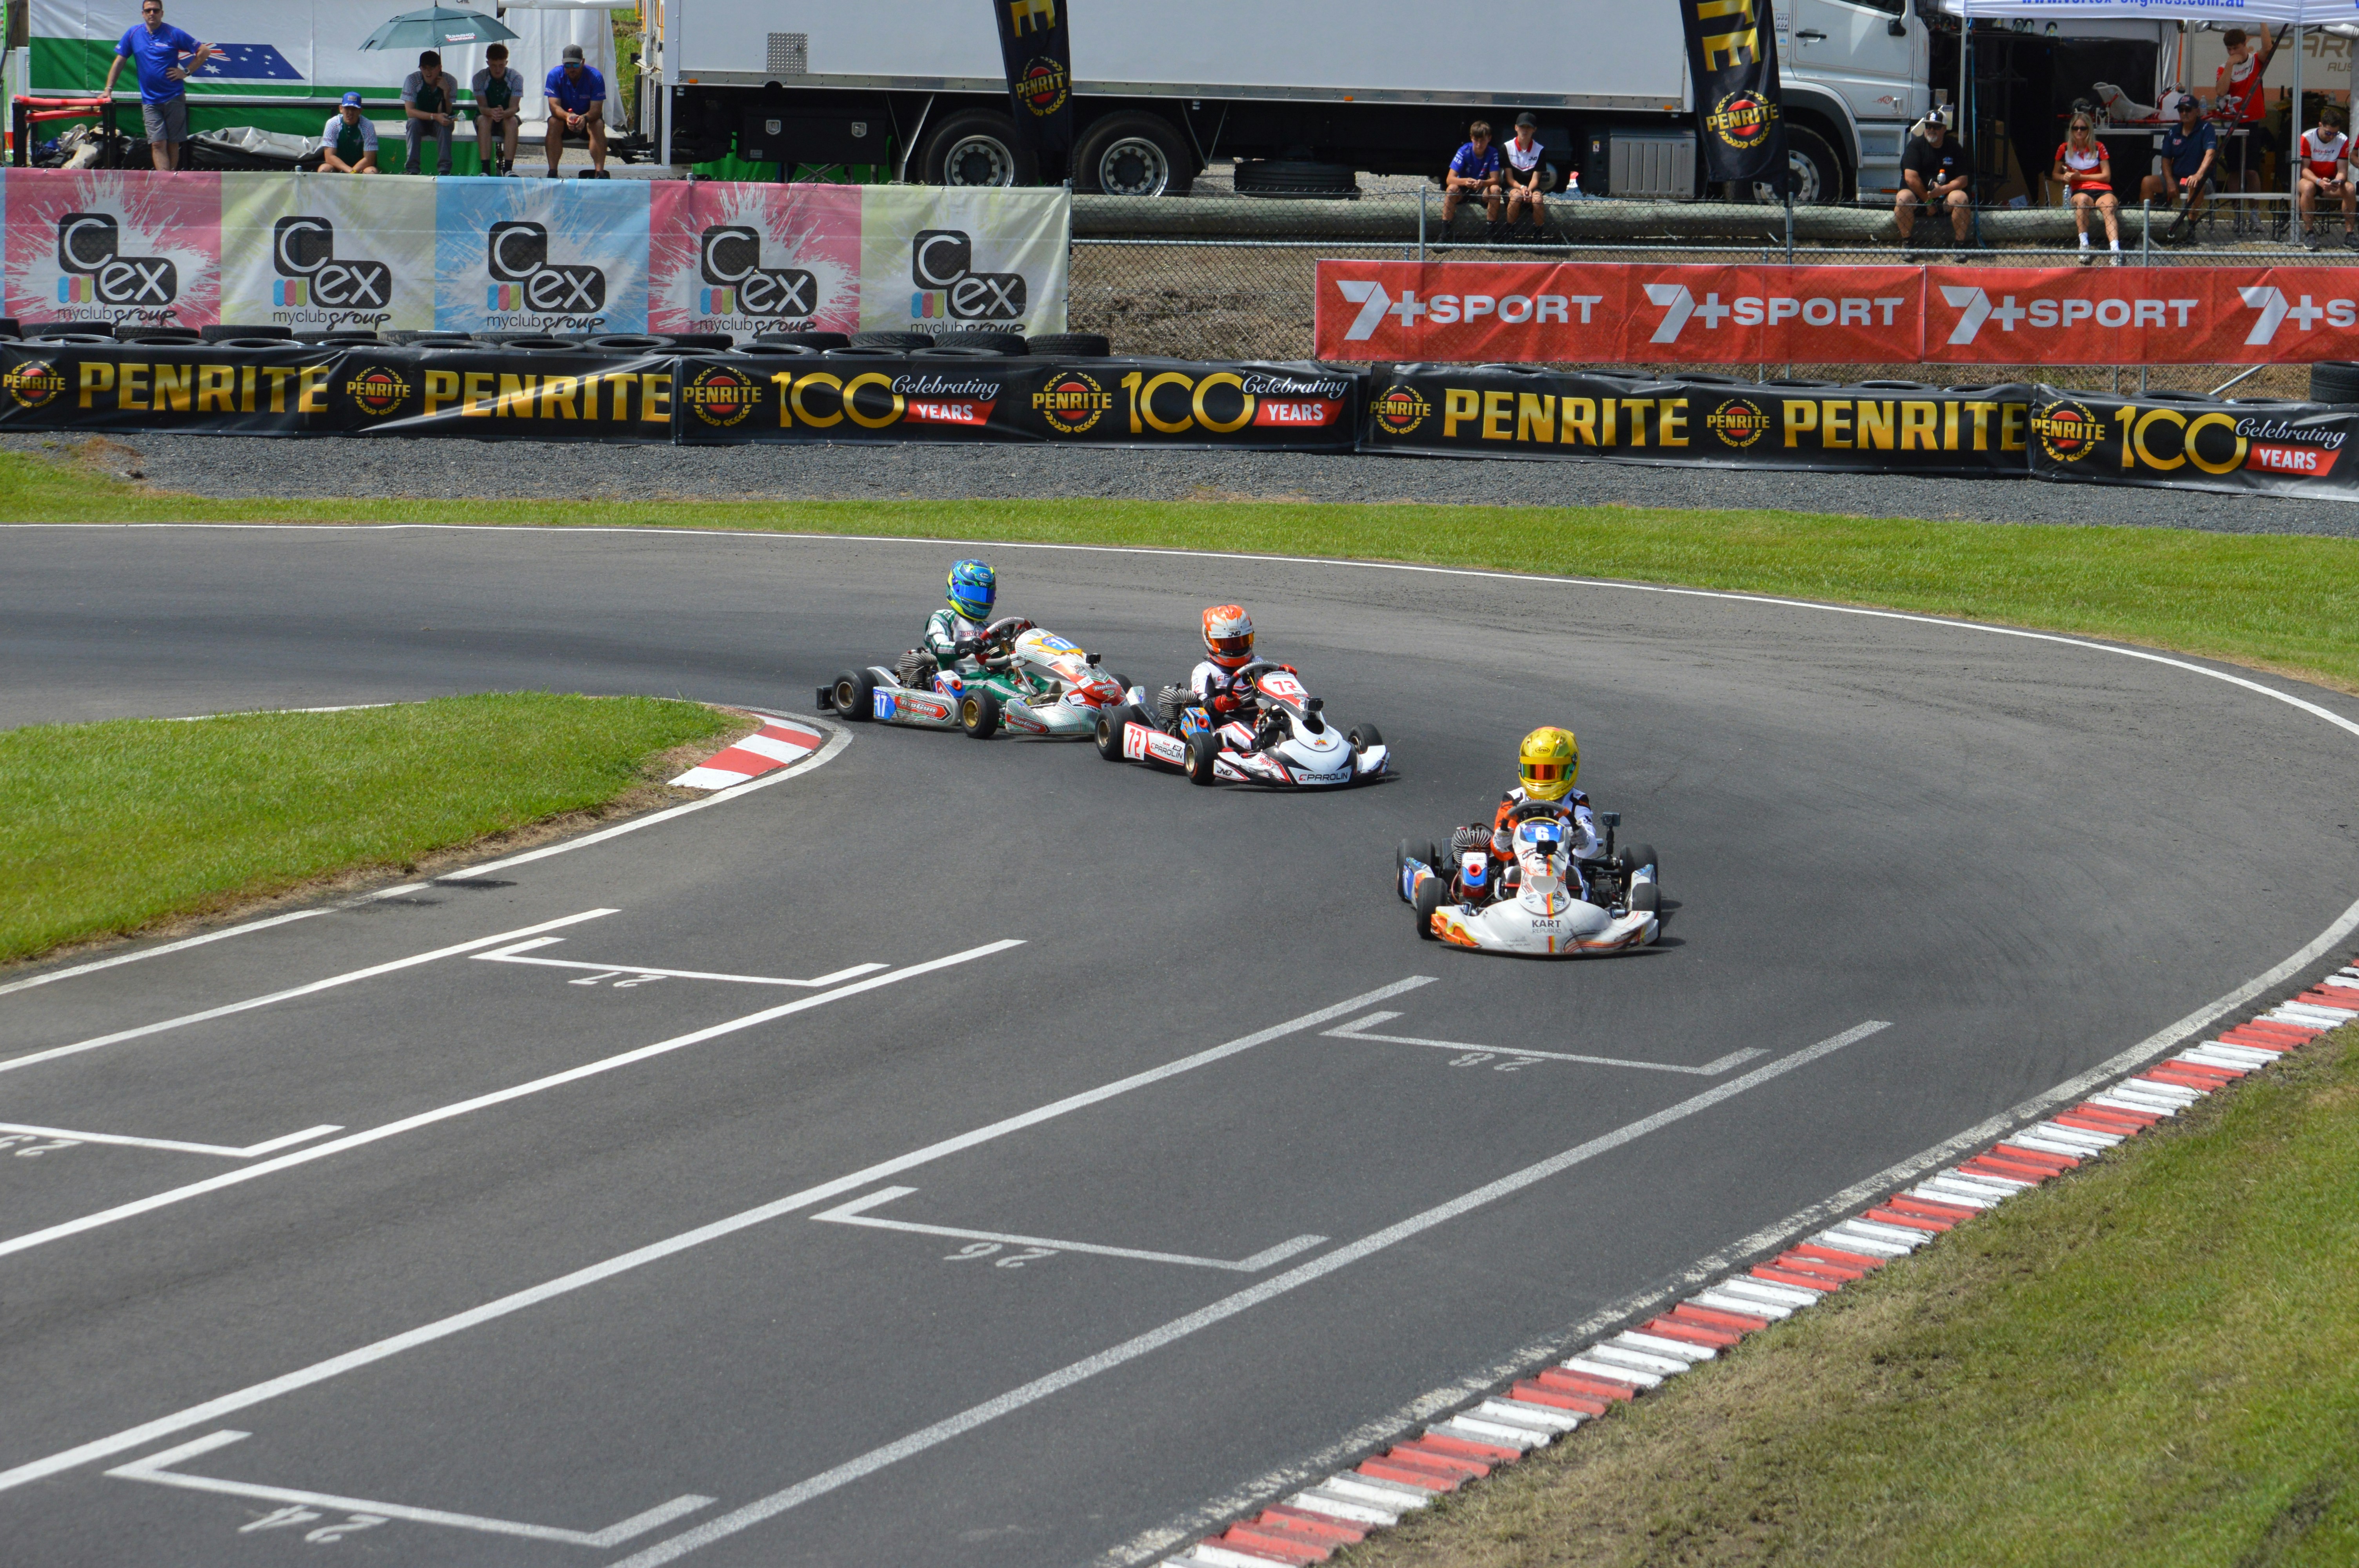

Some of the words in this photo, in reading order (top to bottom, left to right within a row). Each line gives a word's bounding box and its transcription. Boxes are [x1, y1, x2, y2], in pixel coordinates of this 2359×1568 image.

[2269, 34, 2352, 58] PAR
[1706, 103, 1779, 132] PENRITE
[3, 374, 65, 390] PENRITE
[78, 362, 329, 413] PENRITE
[347, 382, 410, 398] PENRITE
[892, 375, 1003, 400] Celebrating
[1243, 375, 1350, 399] Celebrating
[423, 370, 672, 422] PENRITE
[683, 387, 761, 403] PENRITE
[771, 372, 904, 428] 100
[1032, 392, 1112, 409] PENRITE
[1121, 372, 1255, 433] 100
[917, 404, 973, 421] YEARS
[1267, 404, 1323, 421] YEARS
[1370, 401, 1431, 417] PENRITE
[1443, 388, 1689, 447] PENRITE
[1707, 414, 1770, 429] PENRITE
[1782, 400, 2027, 451] PENRITE
[2032, 418, 2105, 441] PENRITE
[2115, 406, 2247, 474] 100
[2235, 418, 2348, 449] Celebrating
[2259, 448, 2316, 470] YEARS
[1051, 637, 1074, 650] 17
[1272, 681, 1302, 693] 72
[876, 694, 887, 717] 17
[900, 698, 938, 713] TopGun
[1010, 716, 1041, 730] TopGun
[1128, 728, 1142, 758] 72
[1154, 745, 1183, 759] PAROLIN
[1217, 767, 1233, 777] JND
[1305, 772, 1348, 781] PAROLIN
[1535, 826, 1549, 840] 6
[1532, 920, 1561, 928] KART
